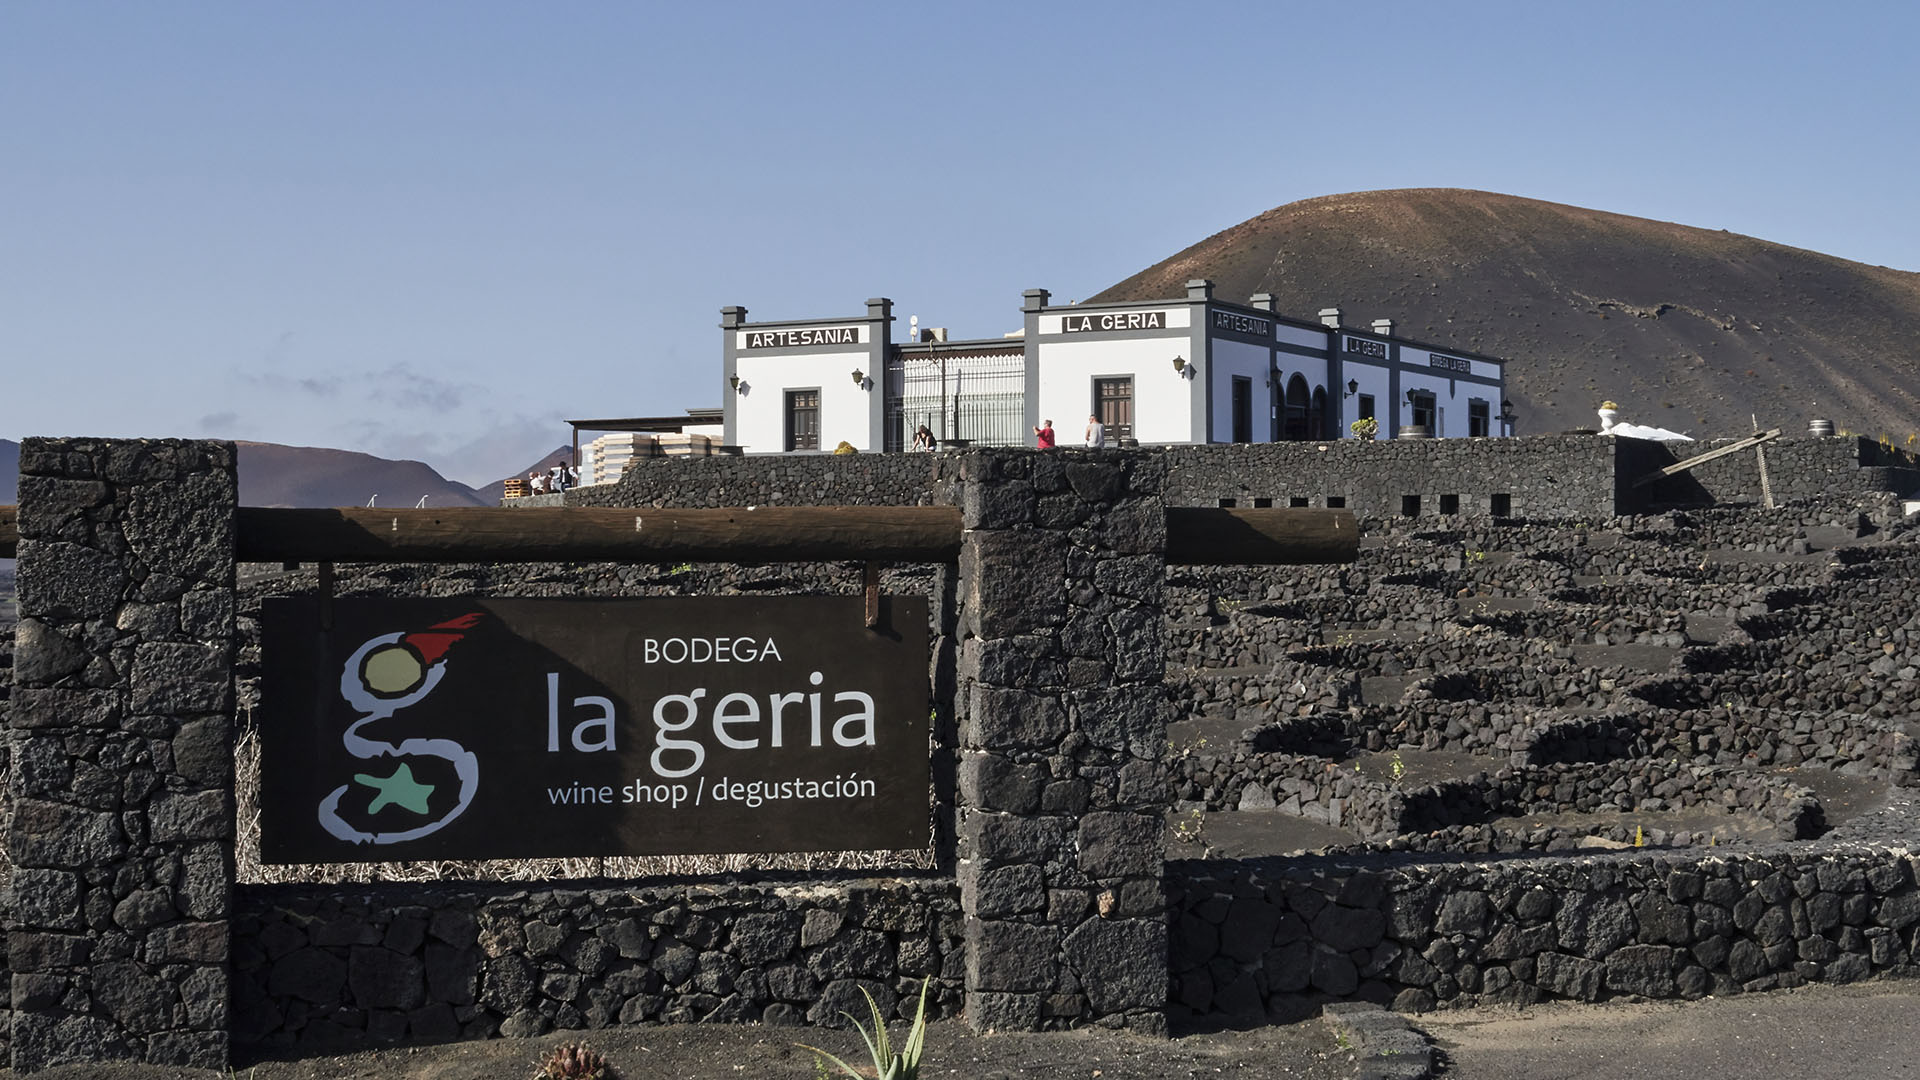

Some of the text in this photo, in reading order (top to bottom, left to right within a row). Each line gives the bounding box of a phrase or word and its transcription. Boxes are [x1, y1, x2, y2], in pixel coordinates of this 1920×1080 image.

[1066, 313, 1160, 332] LA GERIA
[1217, 313, 1268, 336] ARTESANIA
[752, 329, 853, 347] ARTESANIA
[1350, 340, 1385, 357] LA GERIA
[644, 637, 782, 664] BODEGA
[547, 671, 876, 779] la geria
[547, 781, 613, 804] wine
[622, 778, 688, 809] shop
[712, 772, 876, 808] degustación
